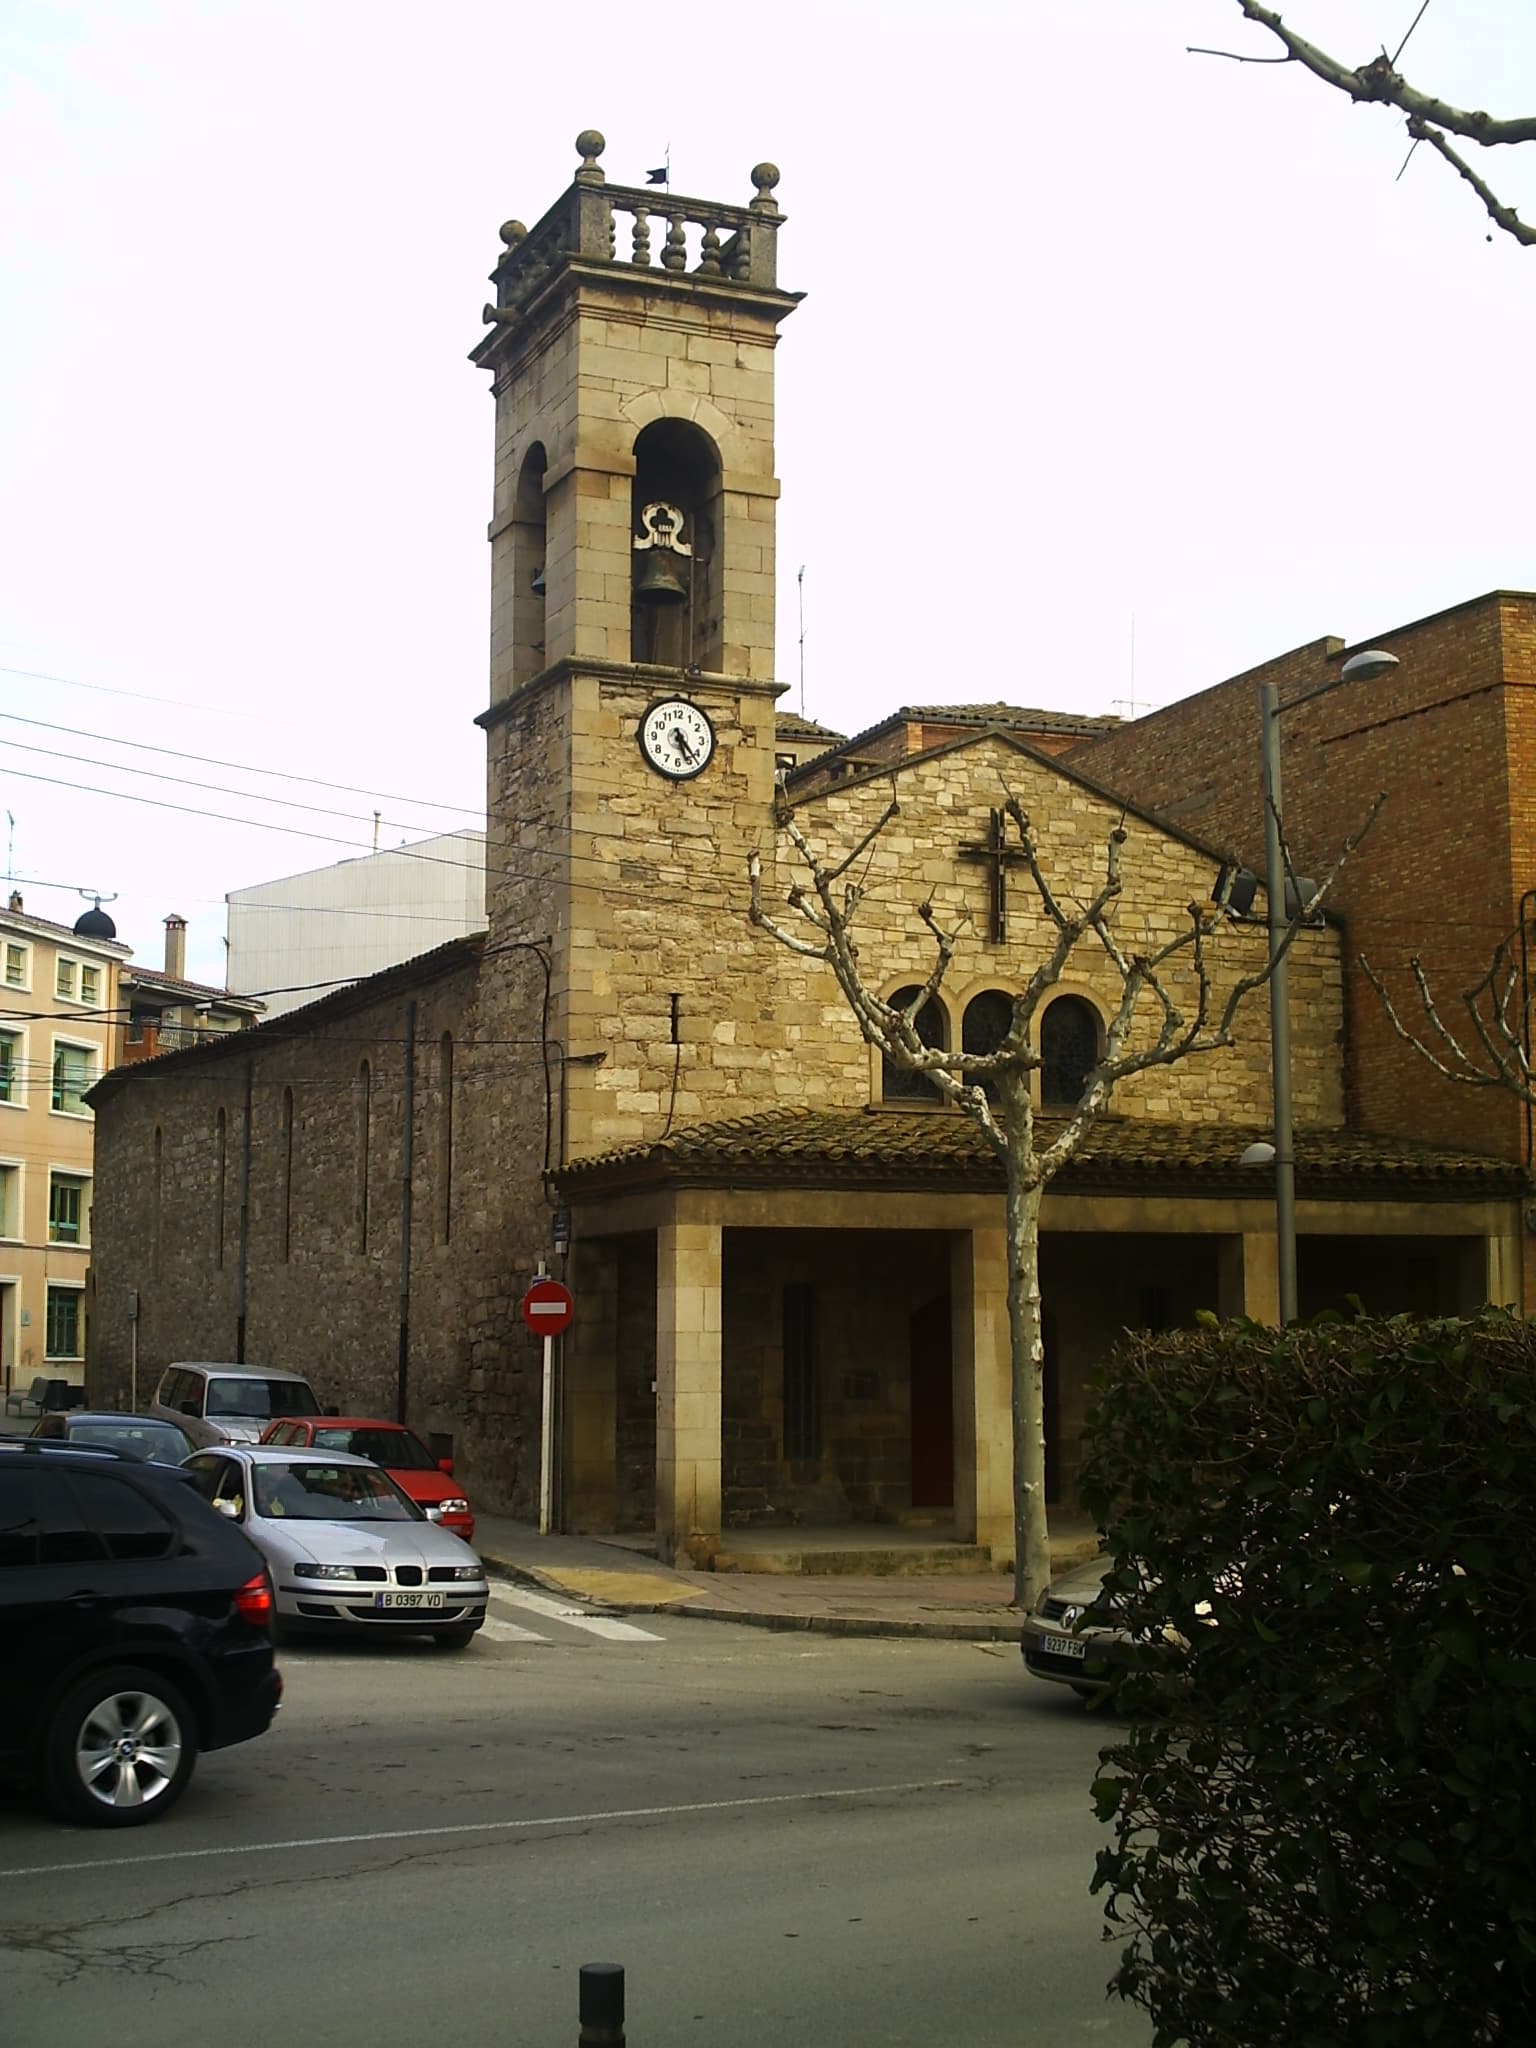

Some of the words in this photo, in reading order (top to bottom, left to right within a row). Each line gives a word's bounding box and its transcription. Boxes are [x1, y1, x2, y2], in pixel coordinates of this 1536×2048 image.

[663, 712, 672, 721] 11
[673, 710, 684, 719] 12
[688, 715, 692, 723] 1
[654, 721, 665, 730] 10
[694, 723, 701, 732] 2
[651, 731, 657, 740] 9
[698, 736, 705, 746] 3
[655, 744, 661, 753] 8
[694, 748, 700, 757] 4
[663, 754, 670, 762] 7
[675, 758, 681, 767] 6
[686, 756, 692, 765] 5
[385, 1594, 392, 1606] B
[396, 1594, 423, 1606] 0397
[427, 1594, 441, 1606] VD
